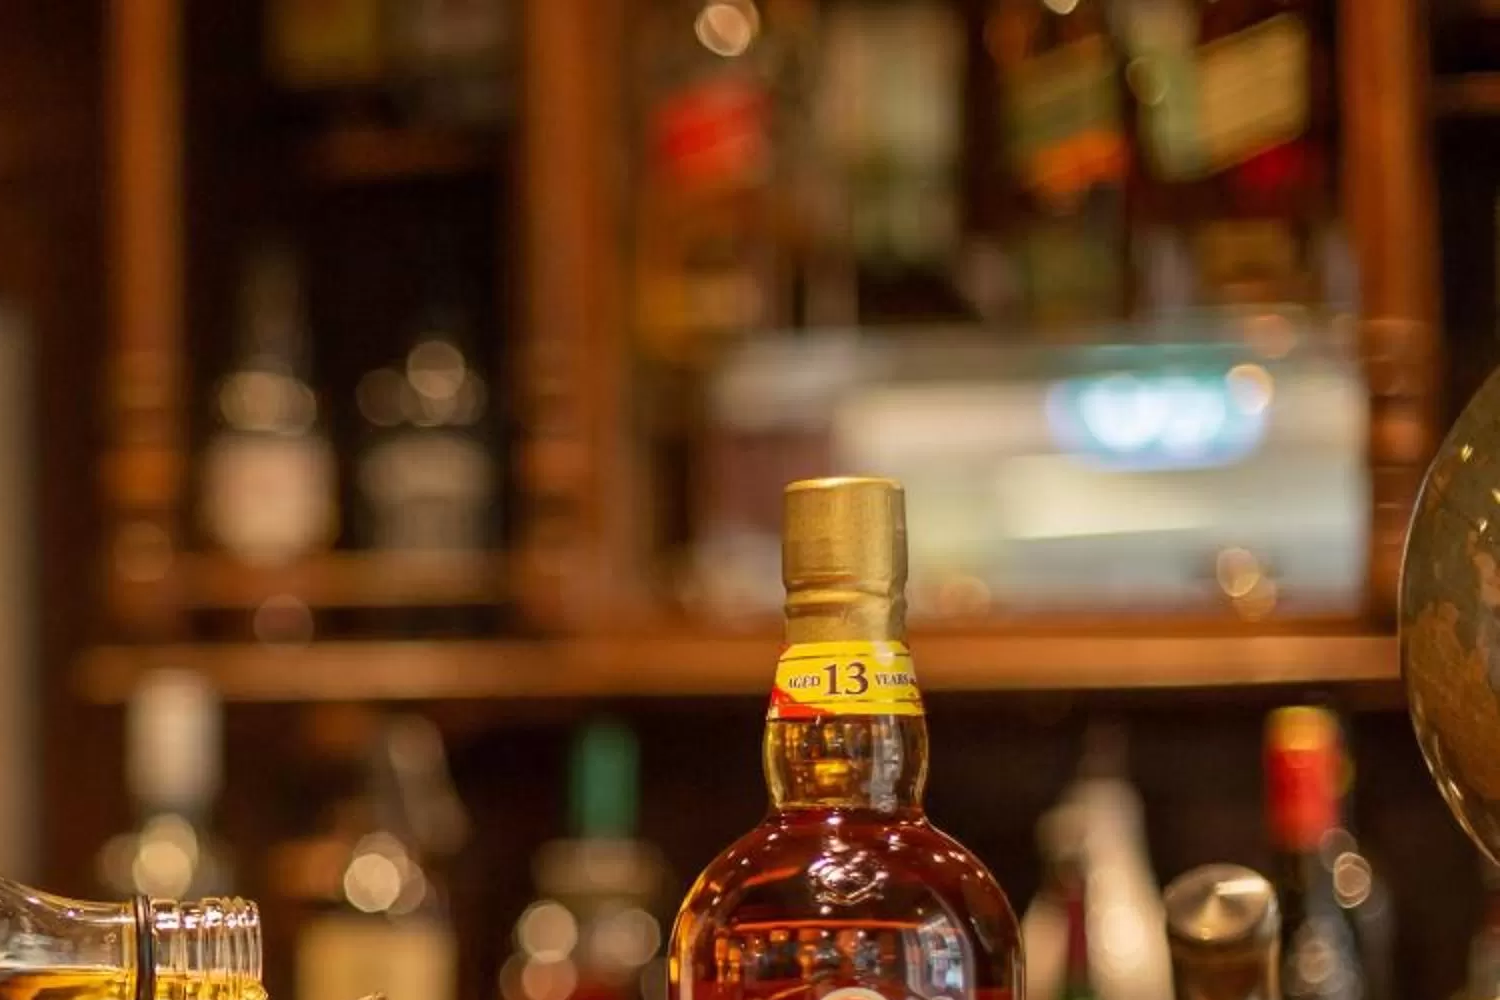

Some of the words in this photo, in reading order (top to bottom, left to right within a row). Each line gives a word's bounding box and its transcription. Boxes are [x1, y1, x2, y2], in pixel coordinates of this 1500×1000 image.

[788, 674, 821, 689] AGED
[822, 661, 869, 696] 13
[875, 672, 910, 686] YEARS
